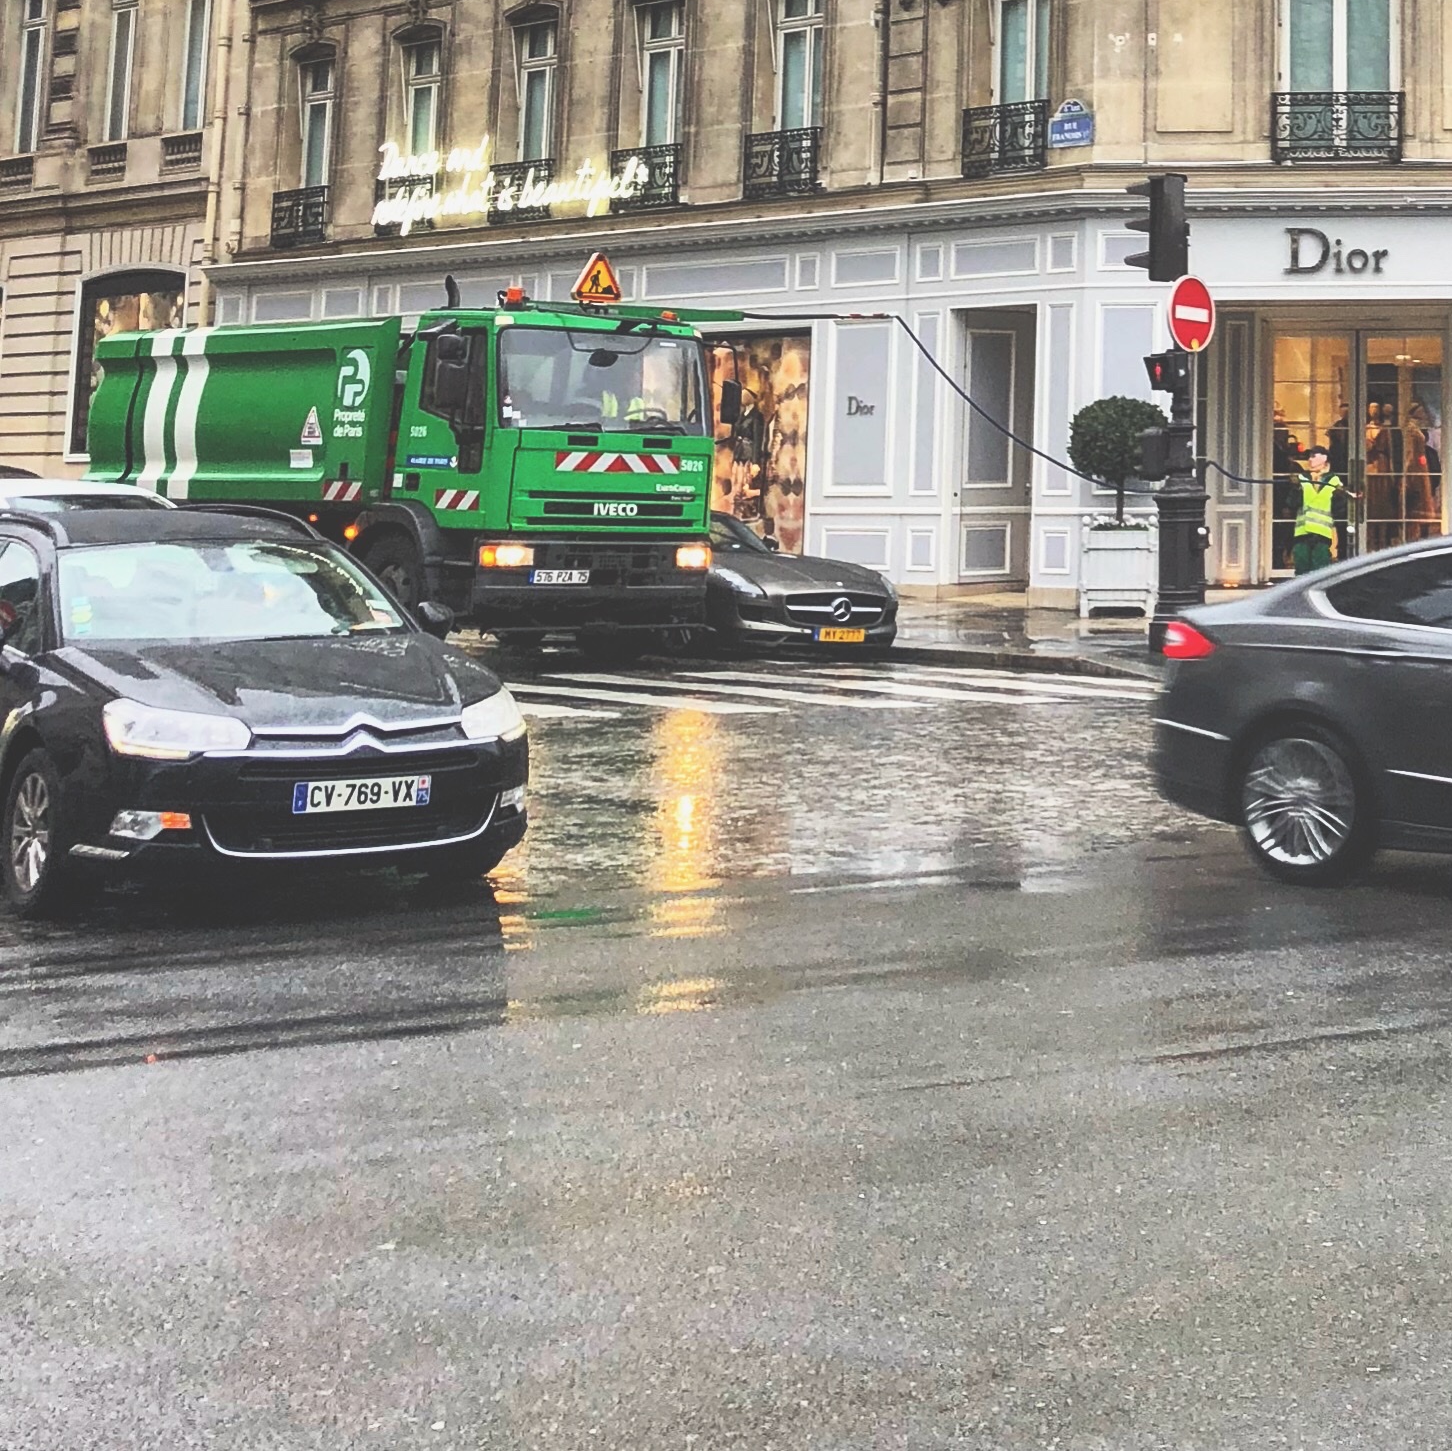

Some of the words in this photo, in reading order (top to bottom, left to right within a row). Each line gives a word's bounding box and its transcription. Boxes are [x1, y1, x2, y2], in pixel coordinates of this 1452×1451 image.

[1284, 228, 1388, 274] Dior
[846, 396, 875, 416] Dior
[333, 409, 366, 423] Propreté
[333, 425, 343, 437] de
[343, 424, 363, 437] Paris
[681, 460, 703, 471] 5026
[594, 503, 638, 516] IVECO
[310, 780, 415, 807] CV-769-VX
